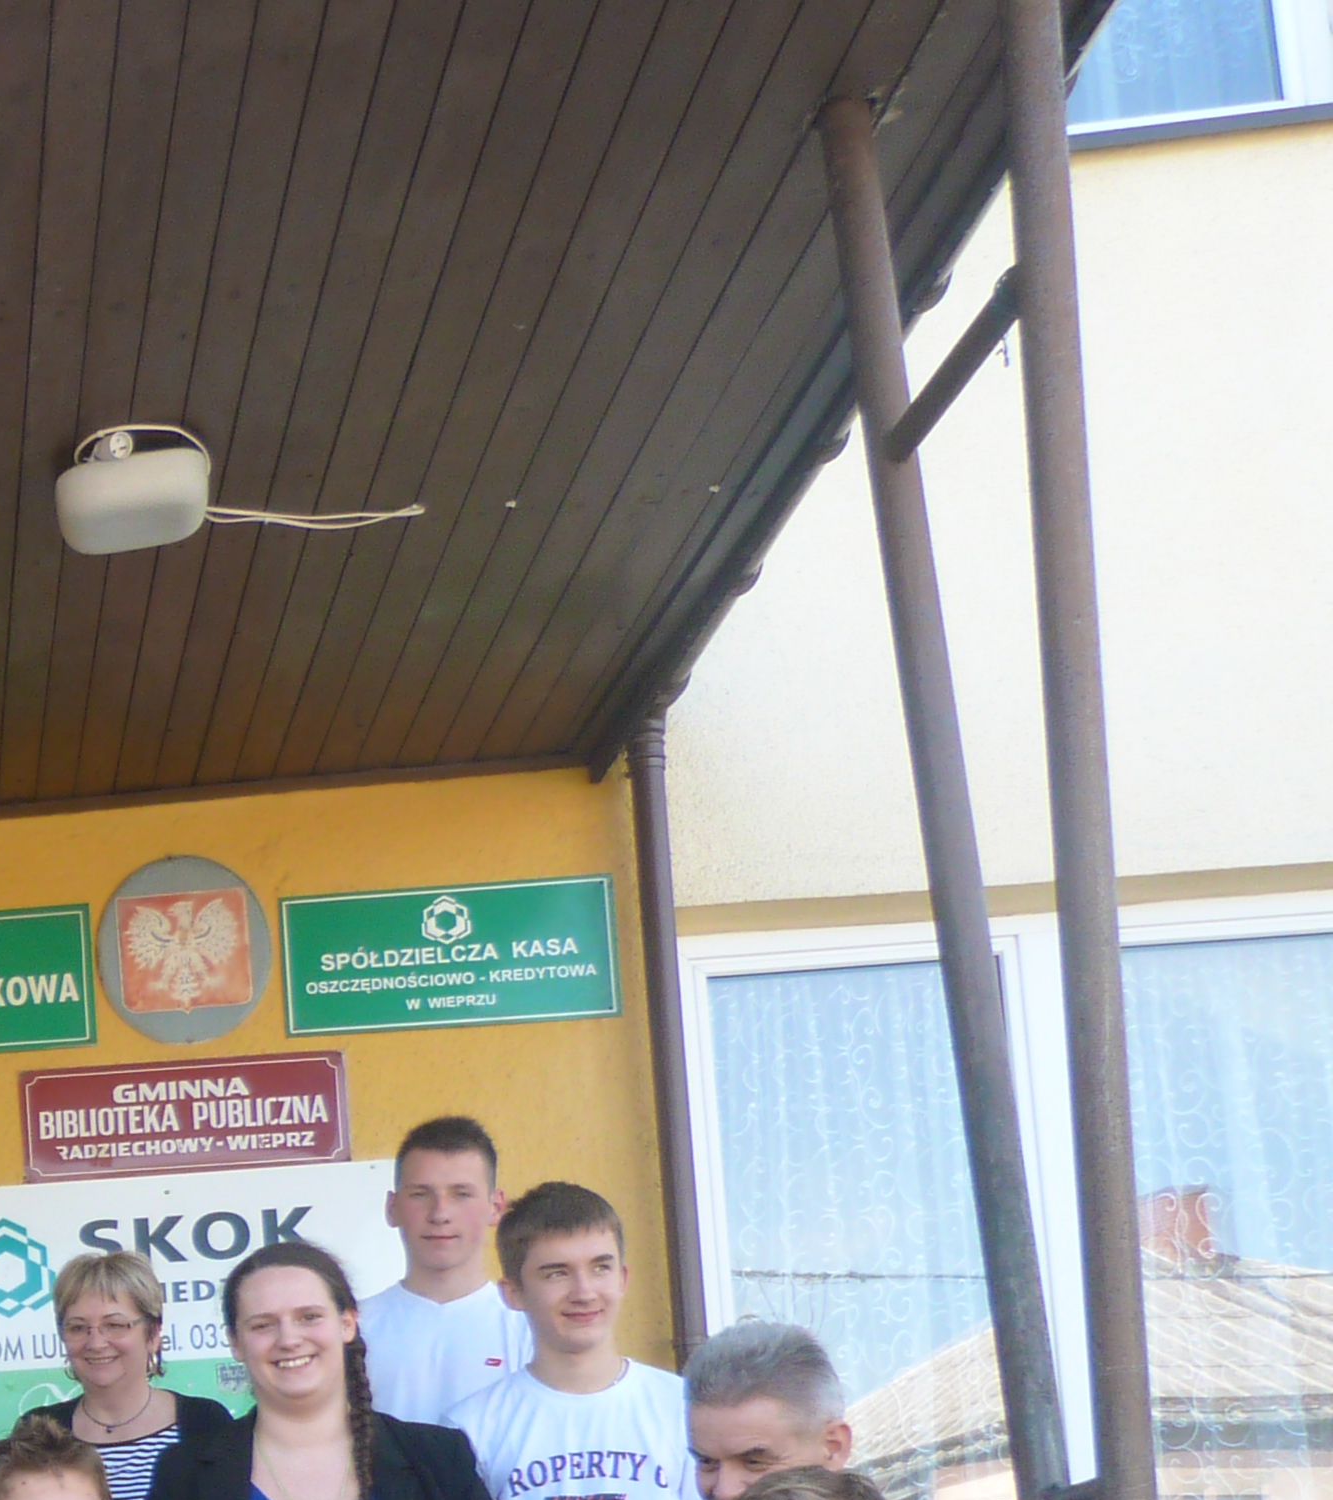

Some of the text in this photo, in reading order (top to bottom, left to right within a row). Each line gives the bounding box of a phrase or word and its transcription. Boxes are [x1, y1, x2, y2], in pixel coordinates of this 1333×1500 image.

[320, 937, 578, 972] SPÓŁDZIELCZA KASA
[305, 971, 475, 995] OSZCZĘDNOŚCIOWO
[489, 963, 597, 984] KREDYTOWA
[405, 993, 497, 1011] W WIEPRZU
[112, 1077, 249, 1104] GMINNA
[39, 1094, 329, 1140] BIBLIOTEKA PUBLICZNA
[79, 1206, 313, 1263] SKOK
[161, 1323, 184, 1352] el.
[506, 1450, 648, 1498] ROPERTY
